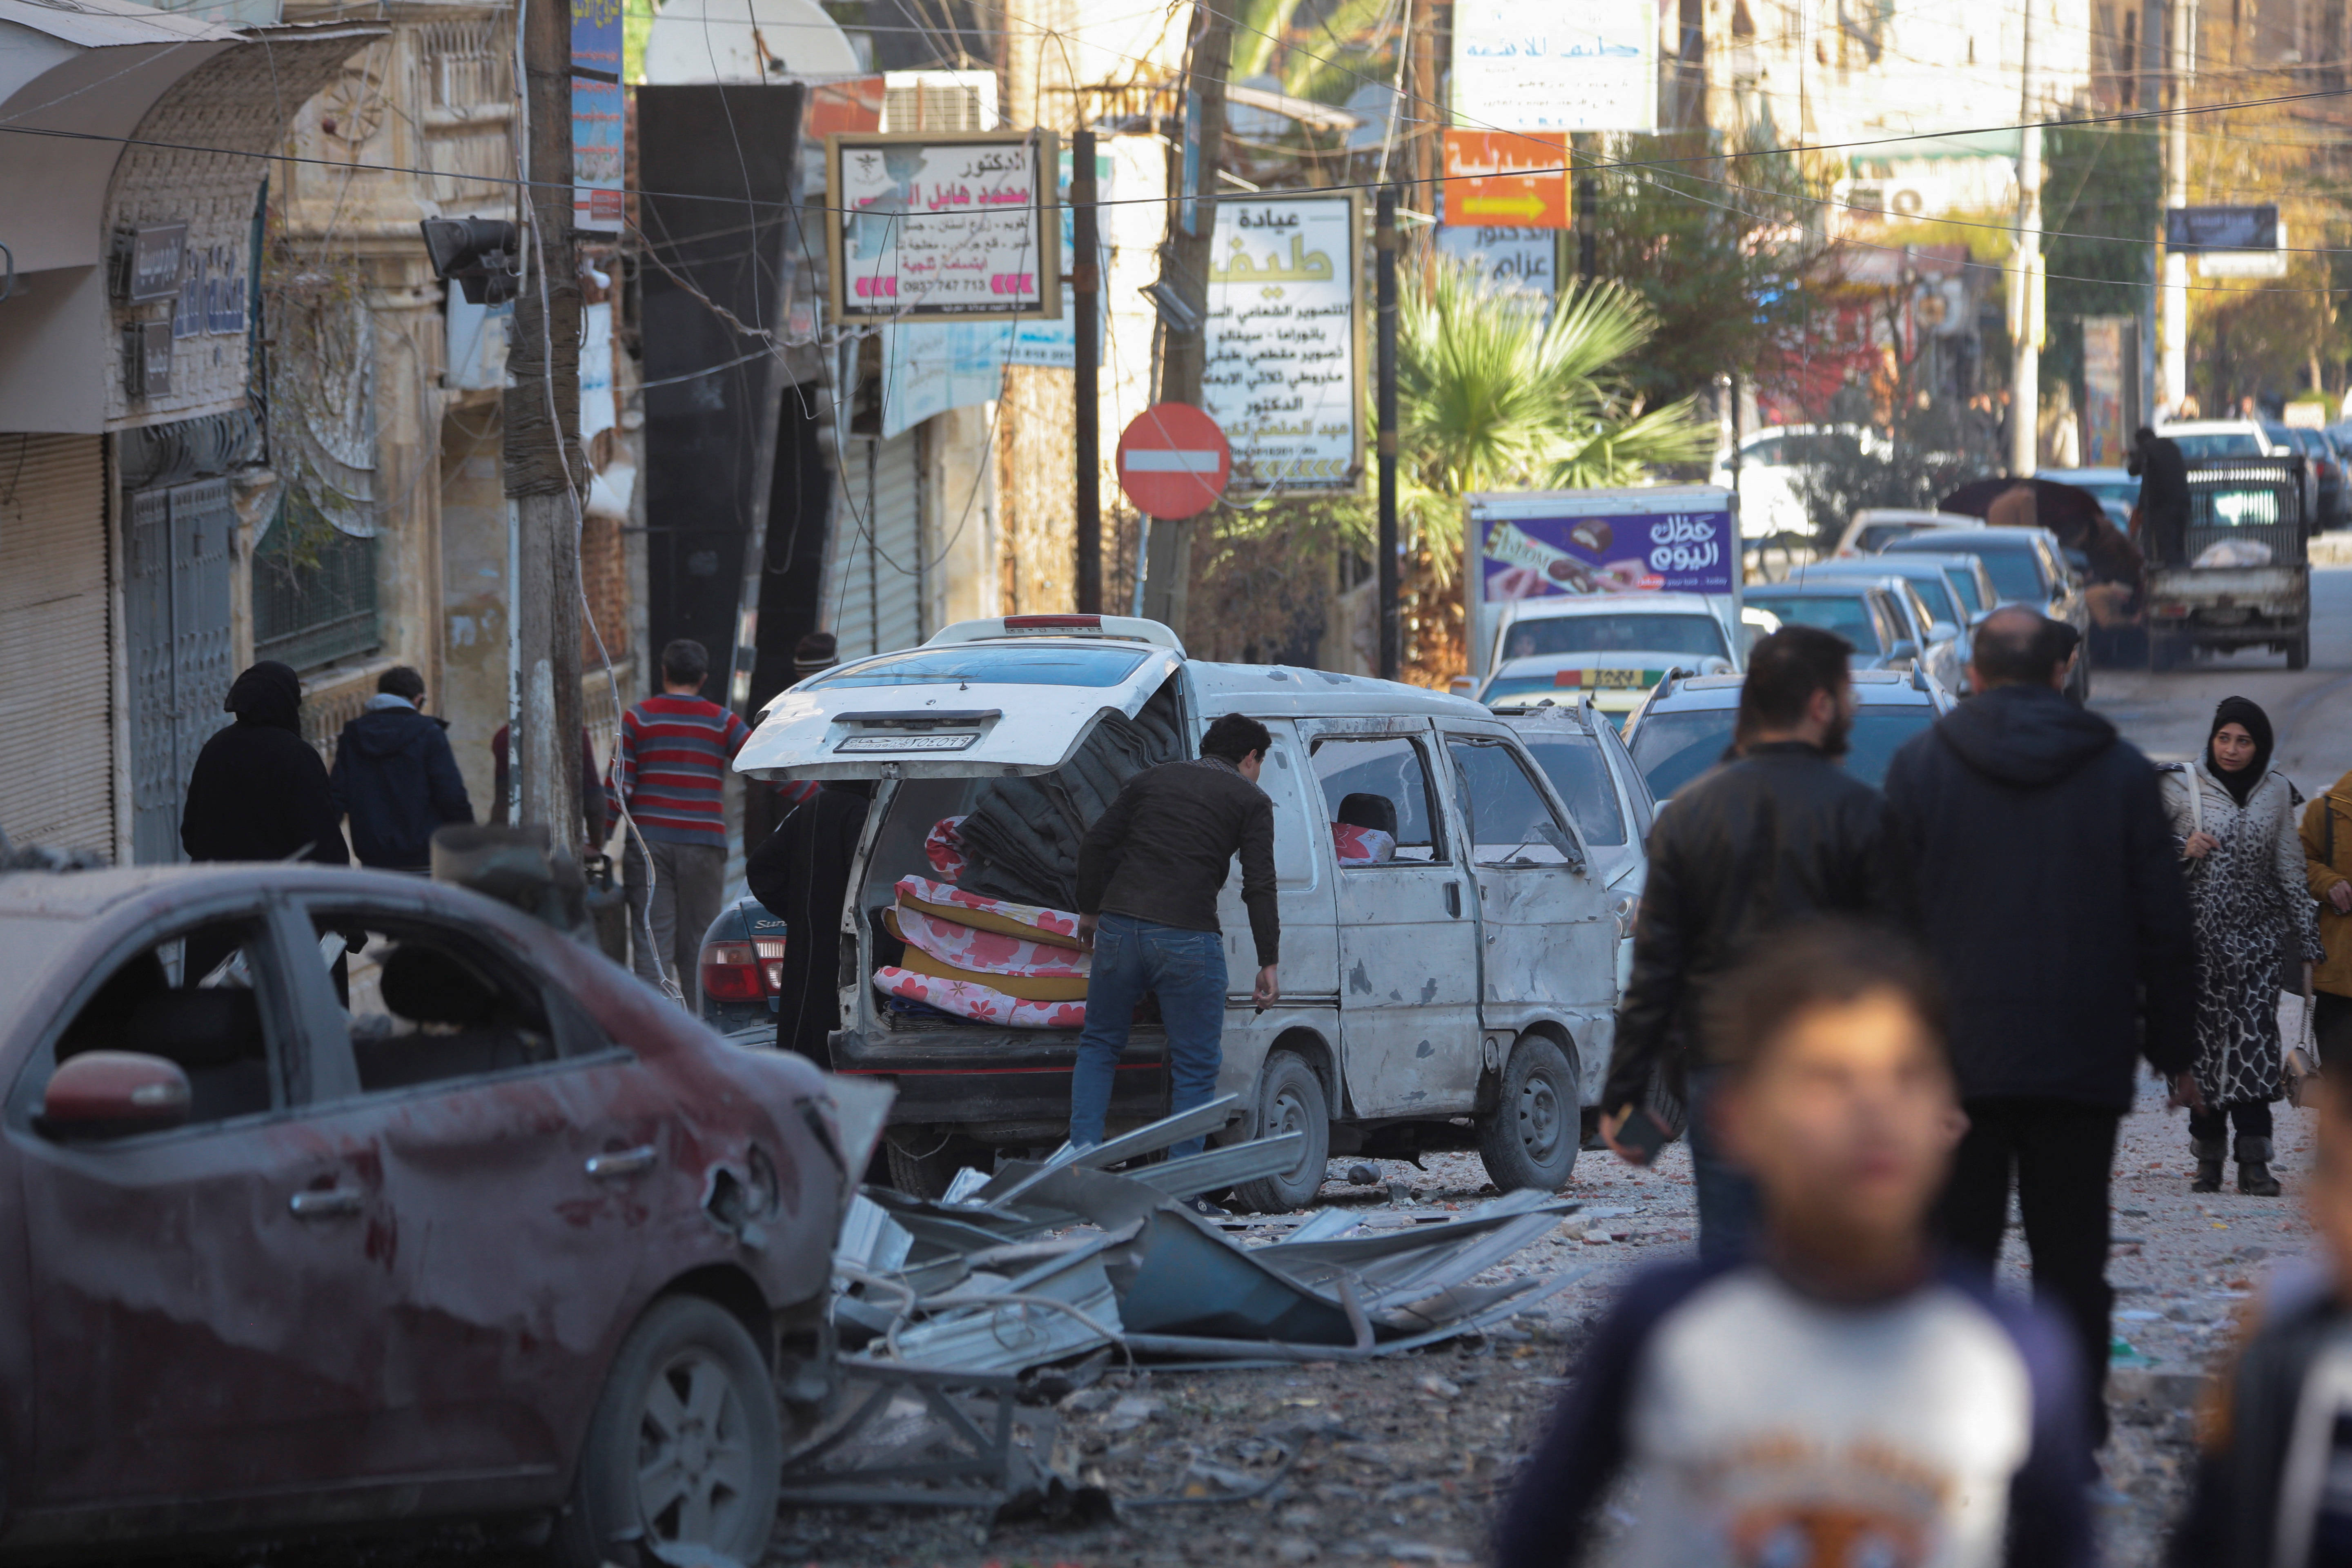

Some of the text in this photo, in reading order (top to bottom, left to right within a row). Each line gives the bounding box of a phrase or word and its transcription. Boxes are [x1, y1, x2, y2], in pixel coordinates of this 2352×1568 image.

[958, 151, 1026, 178] الدكتور
[1448, 142, 1564, 187] صيدلية
[979, 186, 1029, 204] محمد
[1239, 208, 1299, 235] عيادة
[1209, 233, 1334, 298] طيف
[1244, 396, 1303, 416] الدكتور
[754, 920, 788, 929] Sun
